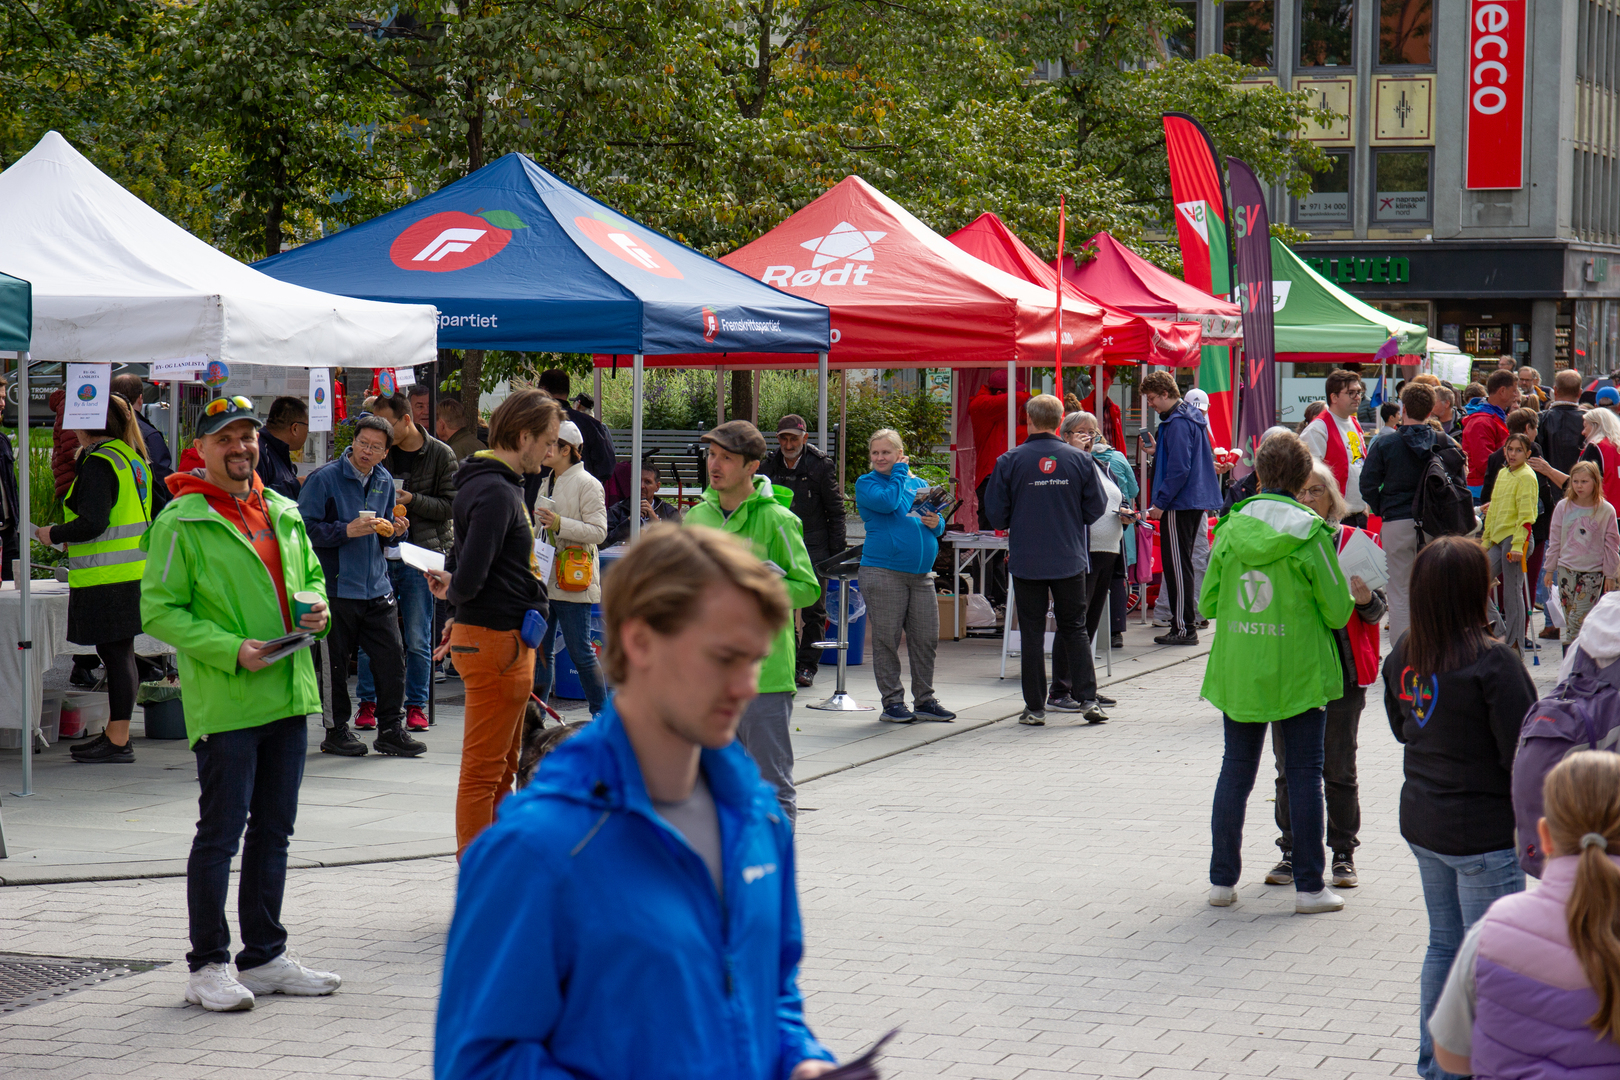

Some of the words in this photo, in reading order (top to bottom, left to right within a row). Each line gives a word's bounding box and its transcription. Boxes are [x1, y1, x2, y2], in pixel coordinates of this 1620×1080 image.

[1473, 4, 1509, 115] ecco
[1395, 196, 1426, 204] naprapat
[1234, 204, 1261, 239] SV
[761, 263, 874, 287] Rødt
[1239, 281, 1263, 314] SV
[720, 318, 782, 335] Fremskrittspartiet
[1227, 620, 1286, 637] VENSTRE
